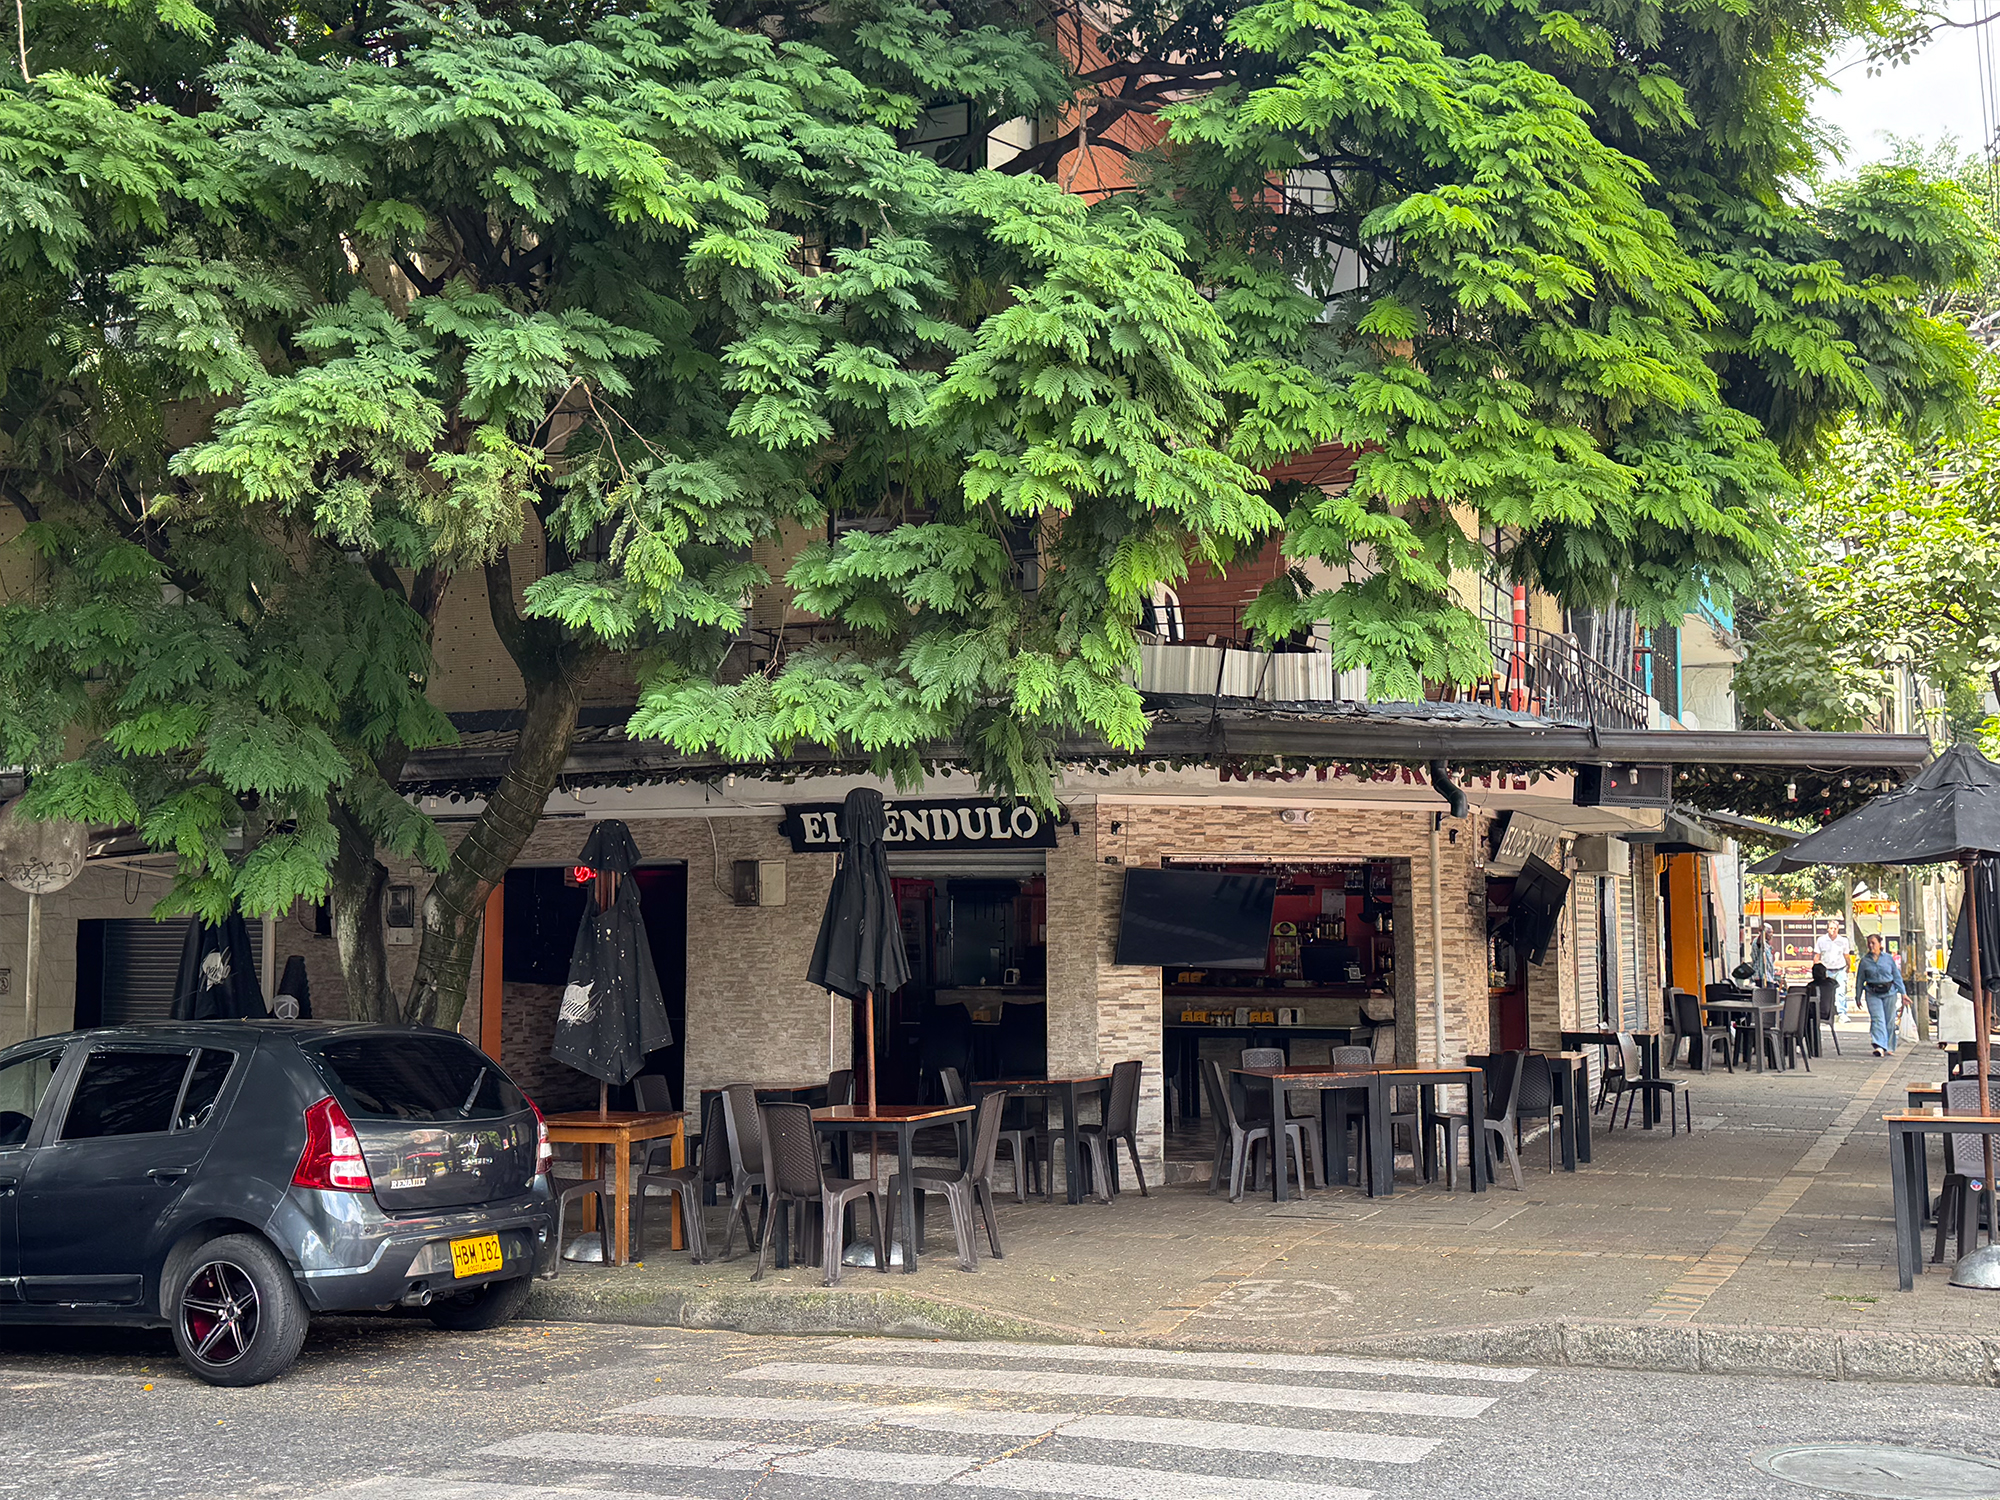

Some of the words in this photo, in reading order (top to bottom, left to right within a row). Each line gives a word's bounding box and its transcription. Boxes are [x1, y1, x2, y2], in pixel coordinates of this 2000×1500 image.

[882, 802, 1039, 842] ÉNDULO
[390, 1177, 427, 1189] RENAULT
[453, 1244, 478, 1267] HBM
[478, 1241, 500, 1262] 182
